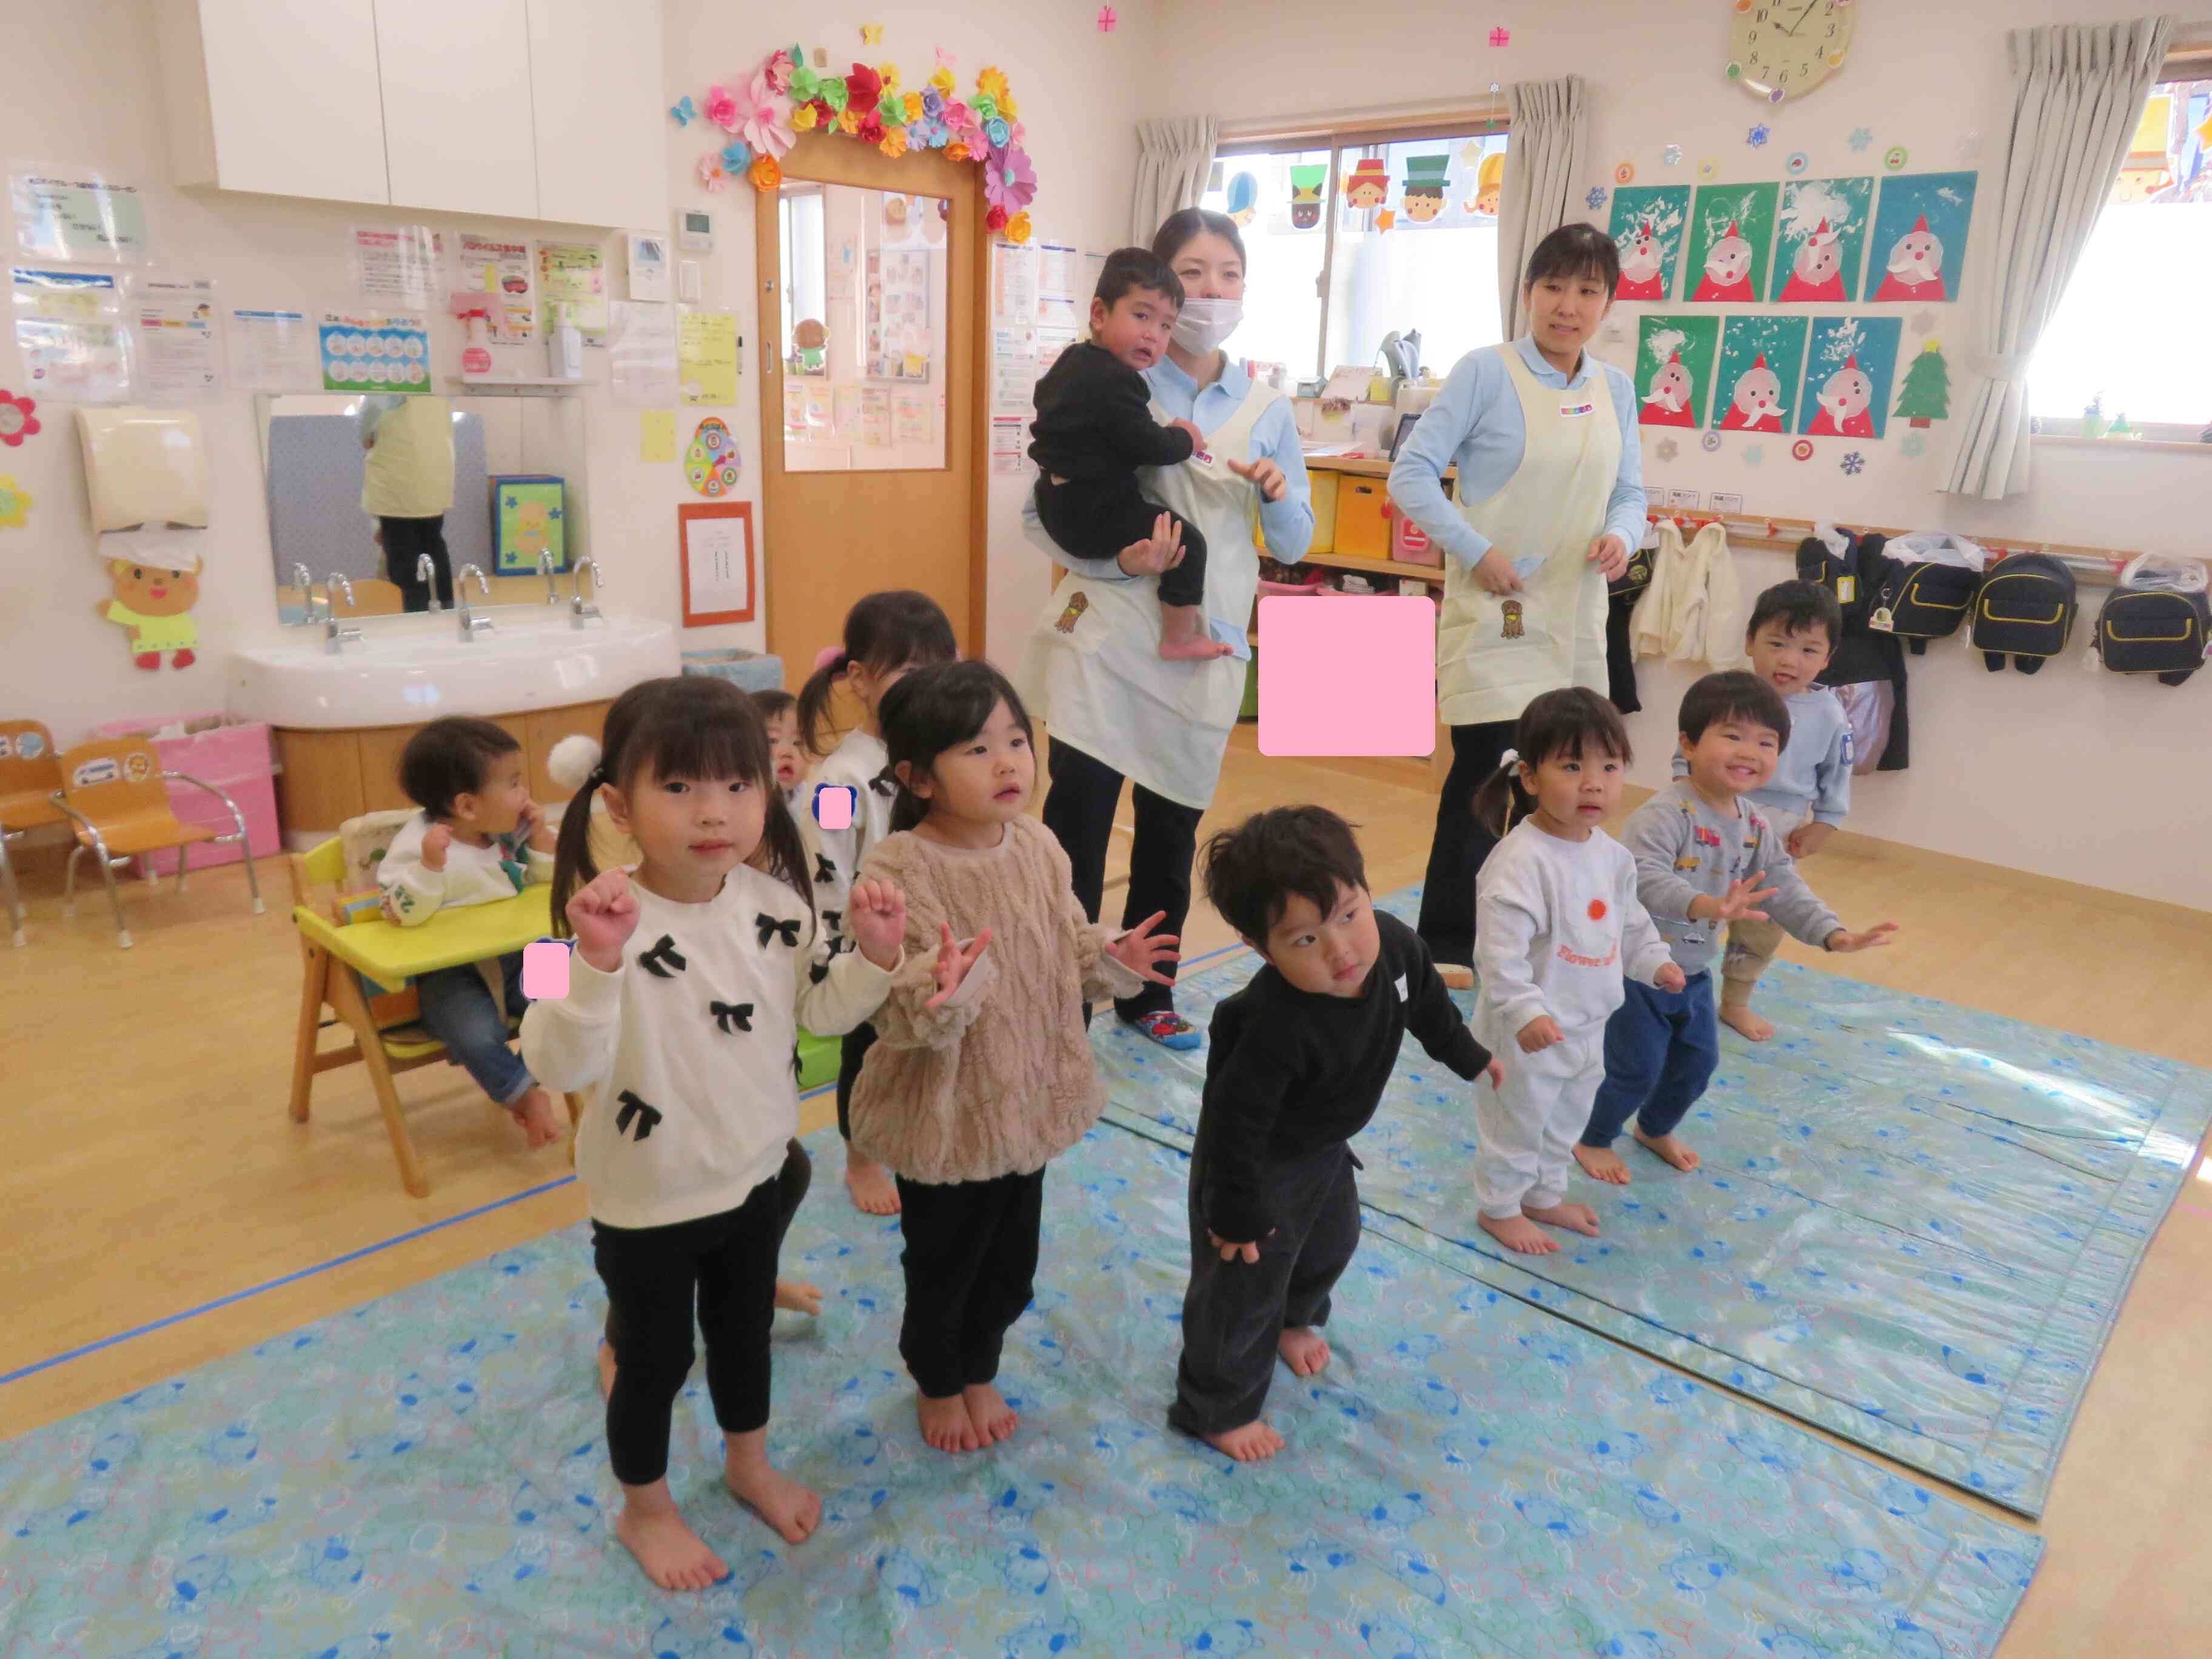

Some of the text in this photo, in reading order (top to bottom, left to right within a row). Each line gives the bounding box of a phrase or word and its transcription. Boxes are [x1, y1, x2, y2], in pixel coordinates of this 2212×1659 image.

[1757, 9, 1768, 23] 10
[1825, 2, 1834, 16] 2
[1748, 30, 1757, 44] 9
[1825, 23, 1835, 38] 3
[1749, 51, 1758, 64] 8
[1815, 44, 1824, 59] 4
[1761, 65, 1770, 79] 7
[1780, 69, 1788, 83] 6
[1800, 63, 1809, 77] 5
